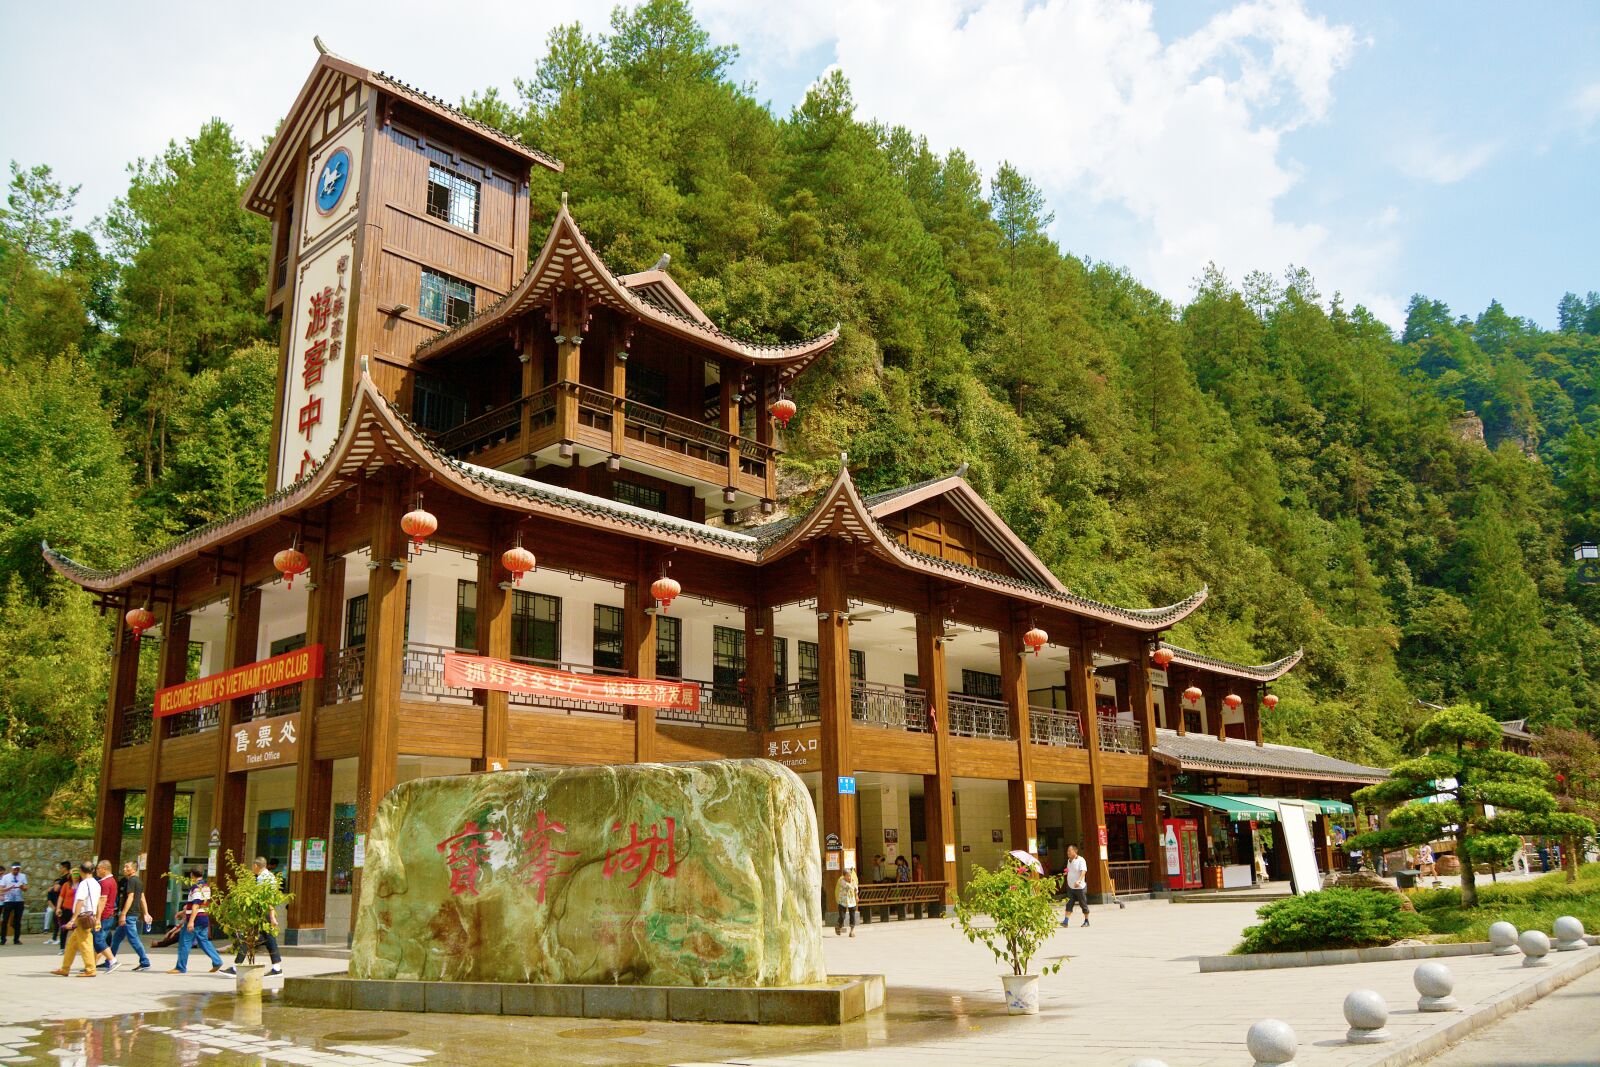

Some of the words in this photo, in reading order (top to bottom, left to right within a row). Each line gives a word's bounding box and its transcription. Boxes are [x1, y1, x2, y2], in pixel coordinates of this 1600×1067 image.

[160, 688, 193, 711] WELCOME
[193, 677, 225, 703] FAMILY'S
[226, 666, 261, 695] VIETNAM
[261, 660, 285, 686] TOUR
[285, 652, 309, 679] CLUB
[234, 720, 297, 753] 售票处
[767, 739, 817, 756] 景区入口
[246, 753, 262, 764] Ticket
[264, 751, 280, 761] Office
